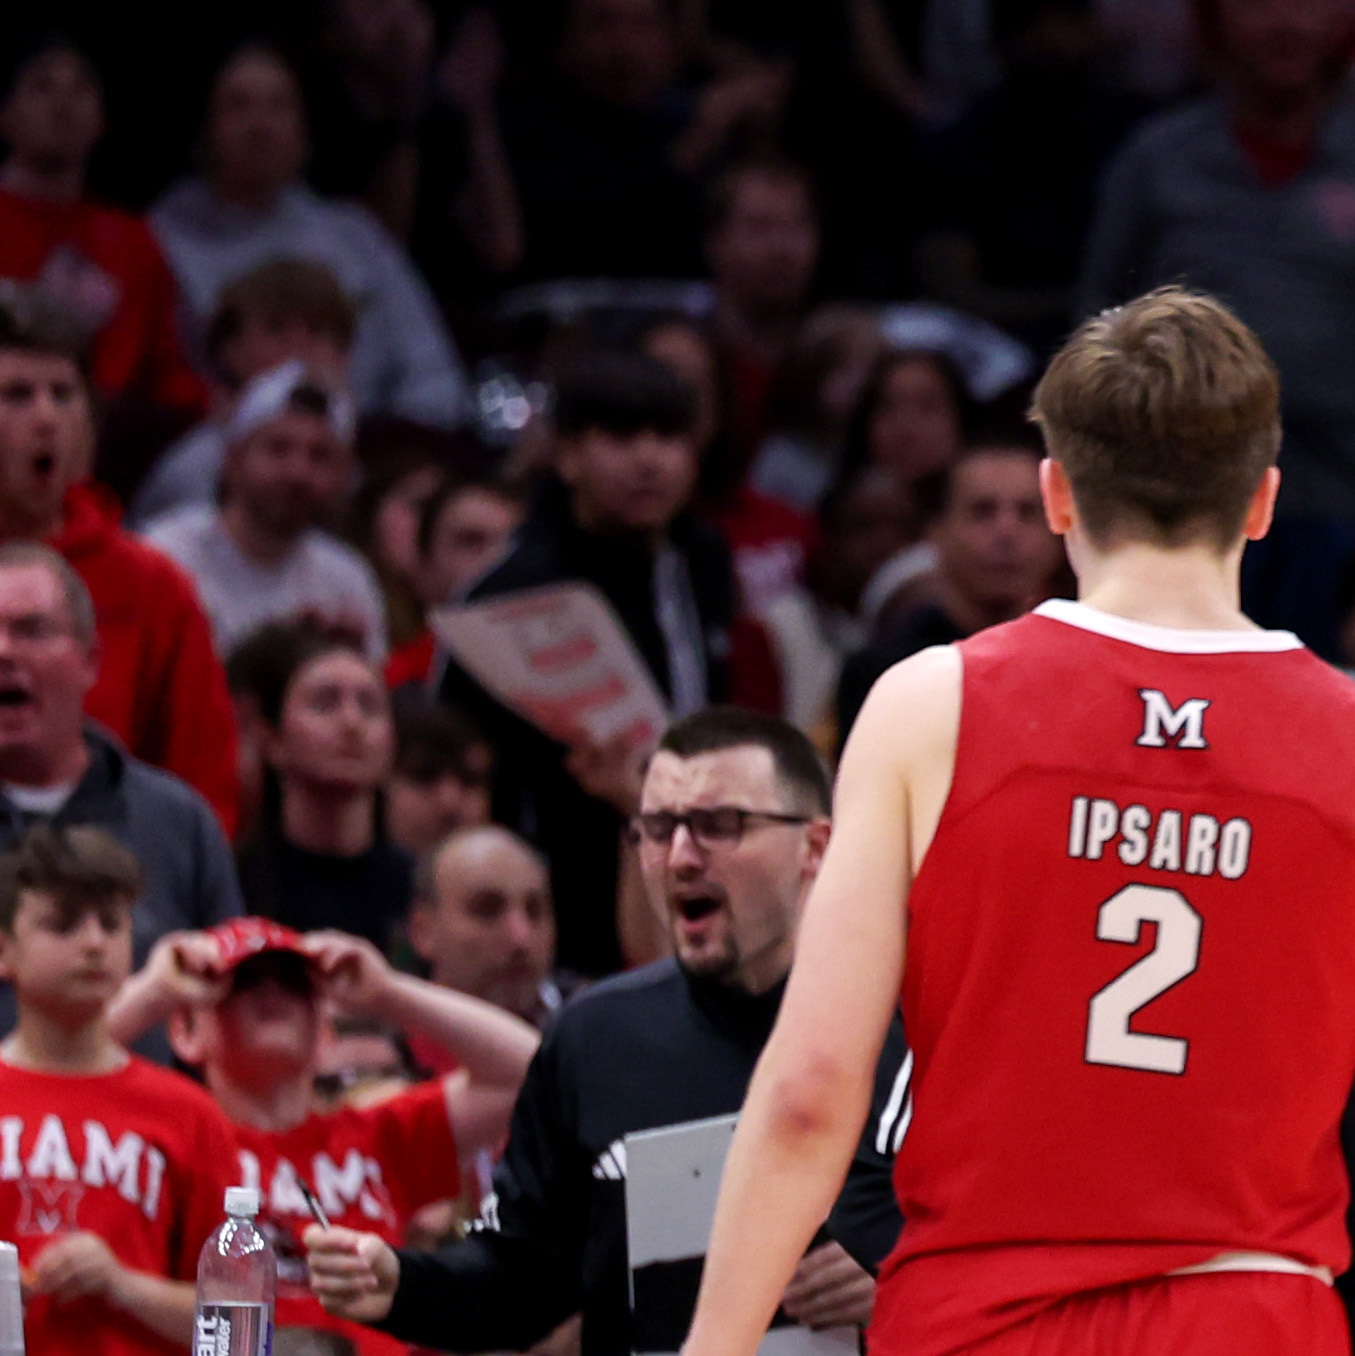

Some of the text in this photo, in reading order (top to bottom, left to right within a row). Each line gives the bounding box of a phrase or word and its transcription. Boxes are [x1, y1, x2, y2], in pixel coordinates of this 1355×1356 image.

[1136, 688, 1213, 749] M
[1068, 795, 1252, 880] IPSARO
[1084, 882, 1205, 1076] 2
